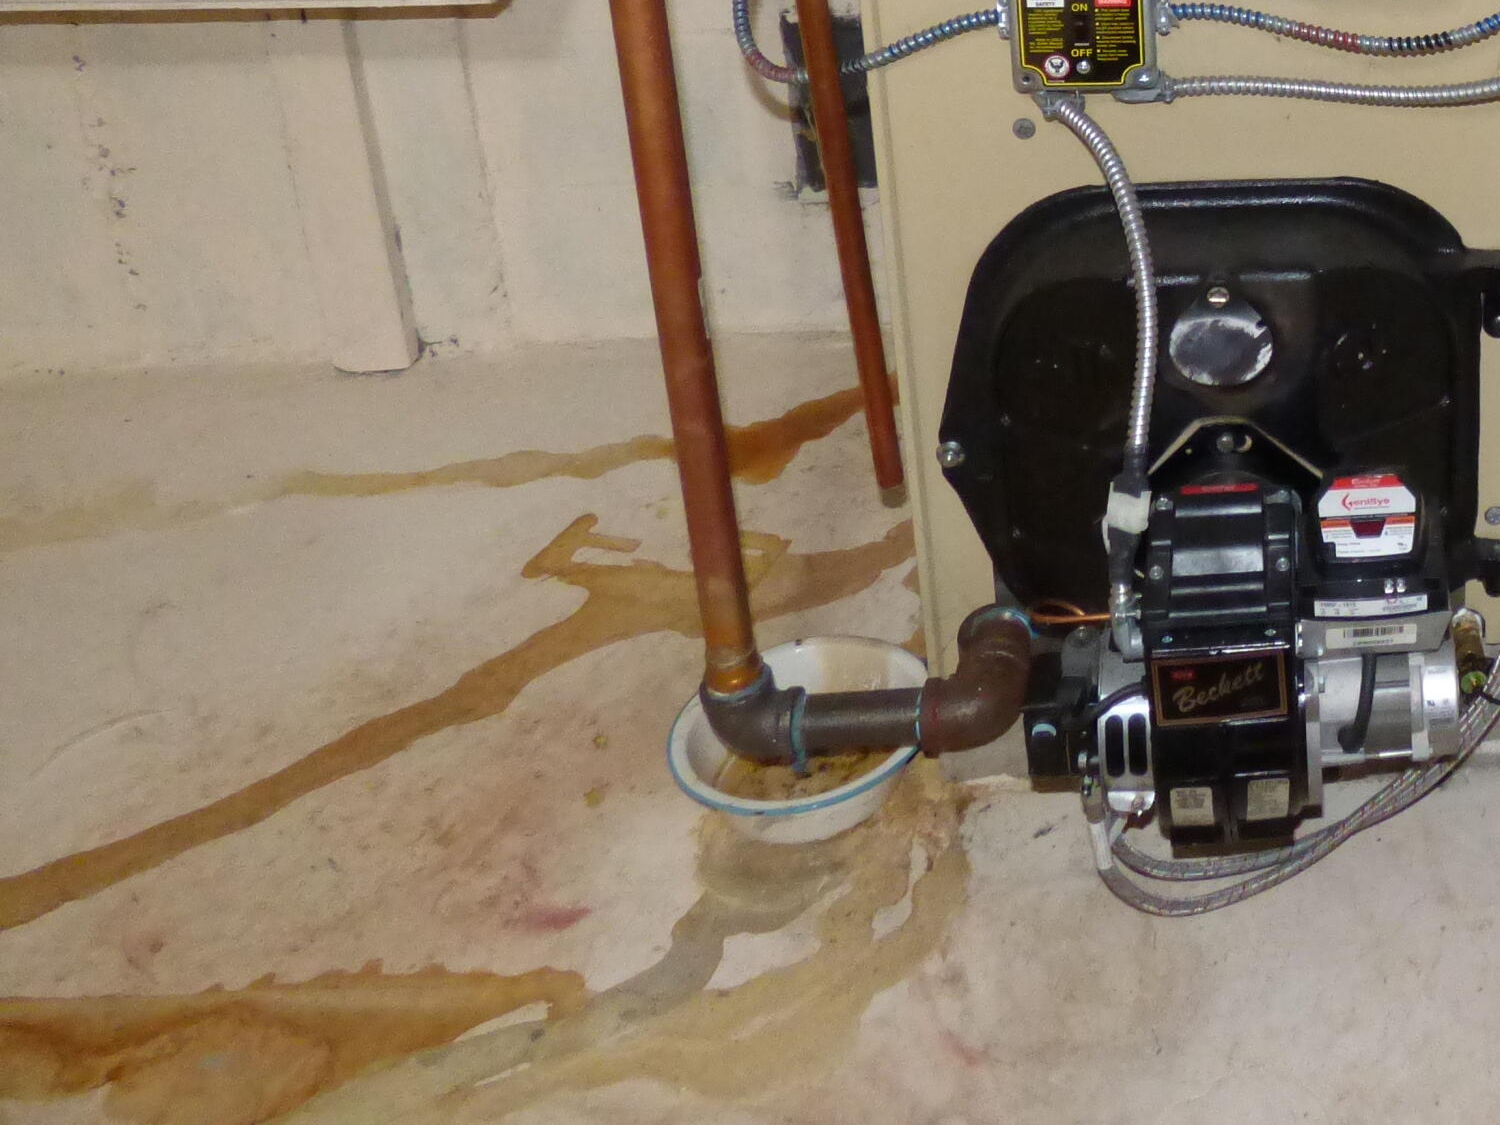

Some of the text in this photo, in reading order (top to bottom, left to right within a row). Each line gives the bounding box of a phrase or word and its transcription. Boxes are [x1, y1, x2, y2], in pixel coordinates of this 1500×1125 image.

[1071, 3, 1088, 12] ON
[1071, 49, 1093, 57] OFF
[1172, 661, 1263, 713] Beckett
